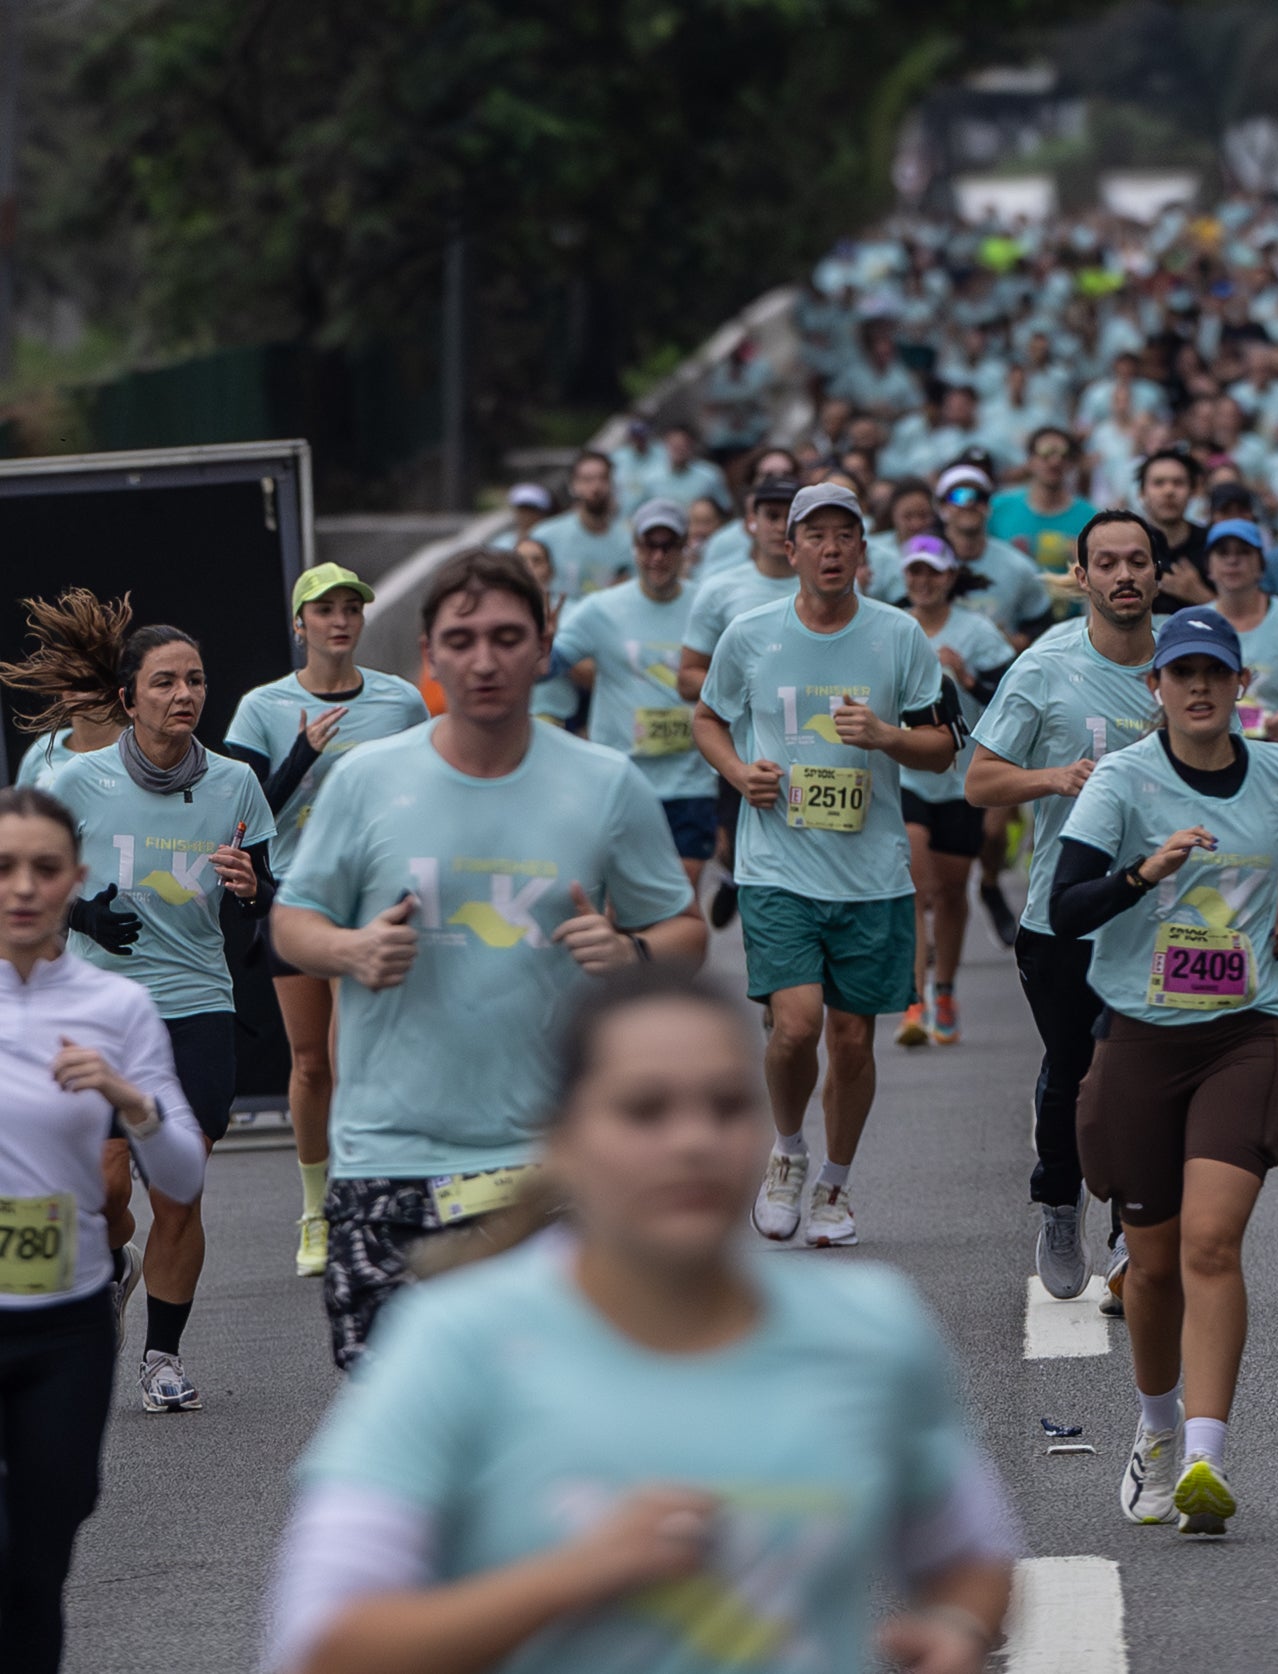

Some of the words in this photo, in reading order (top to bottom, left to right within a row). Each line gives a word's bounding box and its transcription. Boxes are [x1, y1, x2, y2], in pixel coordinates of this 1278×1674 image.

[1116, 718, 1146, 731] FINI
[807, 784, 864, 810] 2510
[145, 835, 216, 852] FINISHER
[1171, 949, 1245, 982] 2409
[0, 1225, 61, 1260] 780
